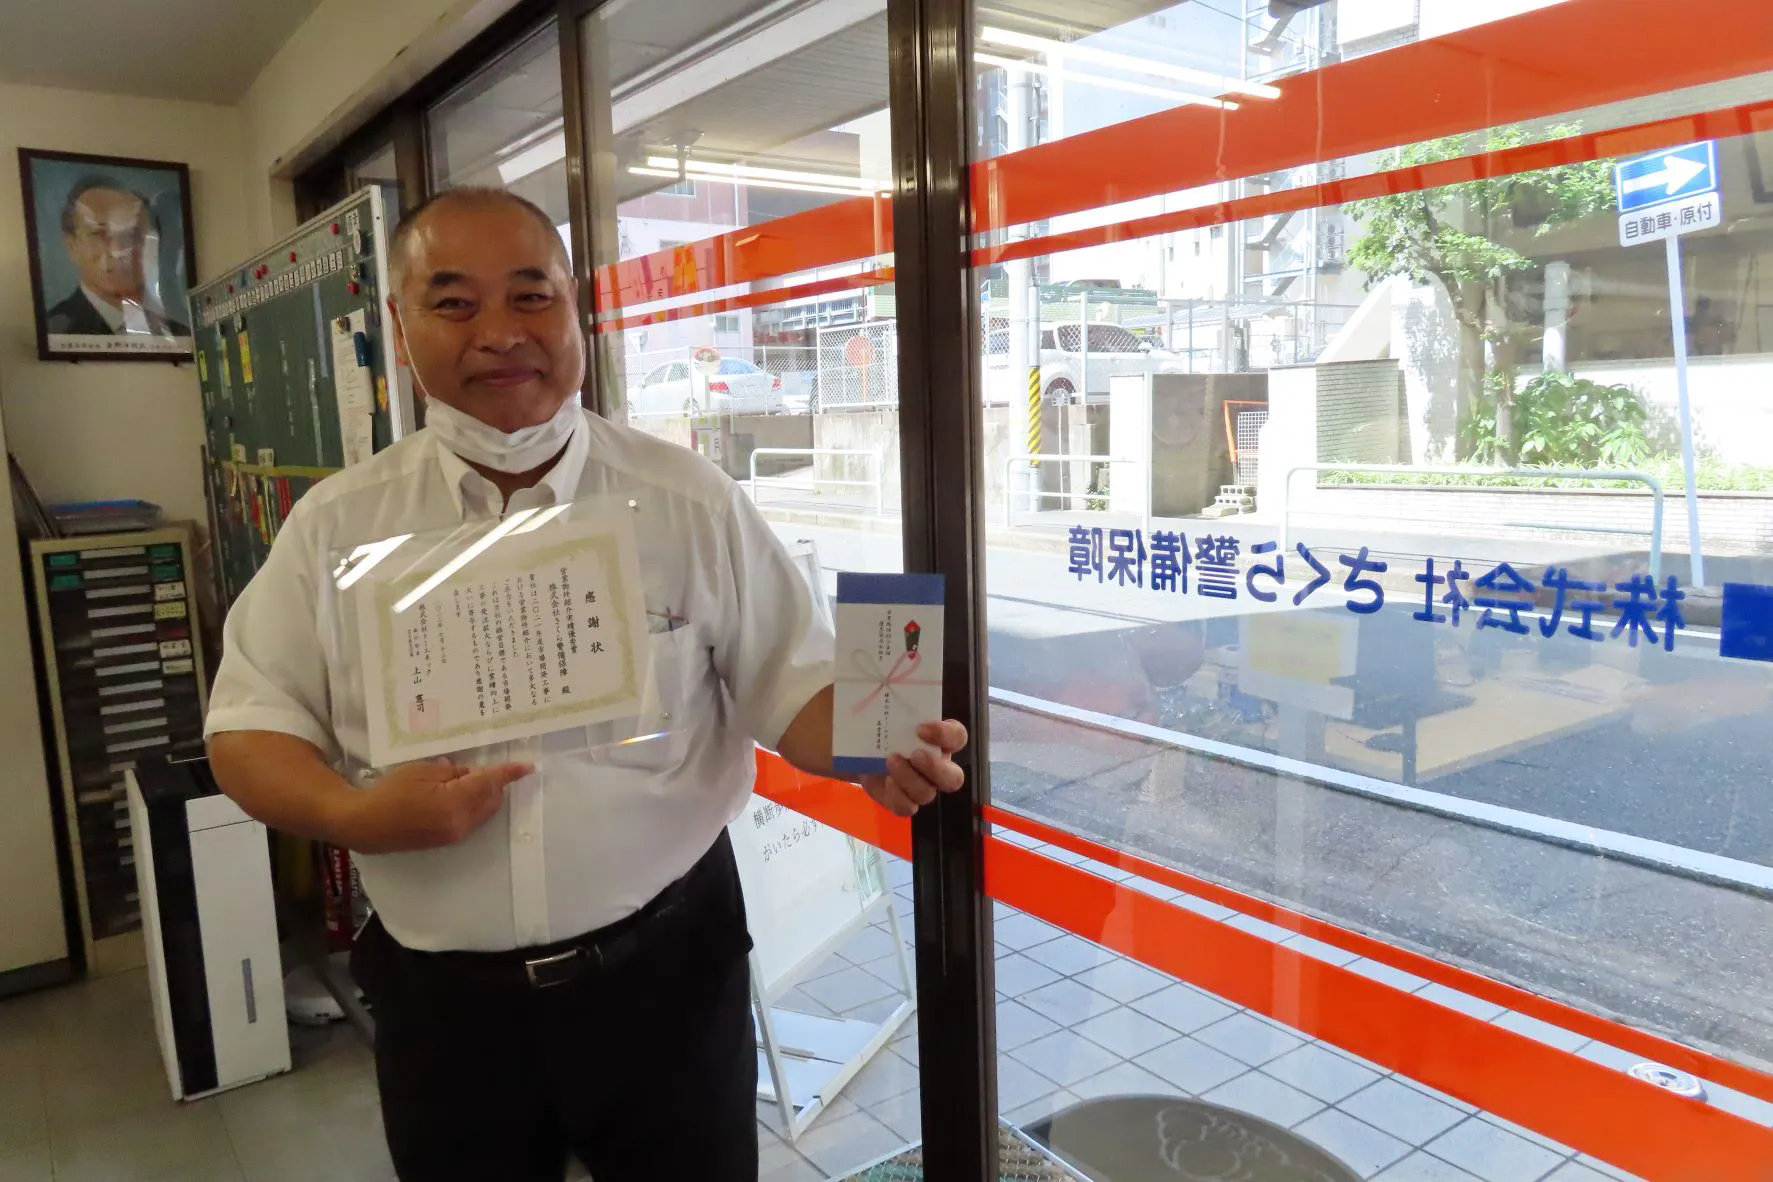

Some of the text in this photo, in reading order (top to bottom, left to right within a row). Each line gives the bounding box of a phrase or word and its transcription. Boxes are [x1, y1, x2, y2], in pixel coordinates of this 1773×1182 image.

[1625, 200, 1712, 239] 自動車・原付
[584, 590, 605, 654] 感謝状
[763, 819, 824, 863] がいたら必ず
